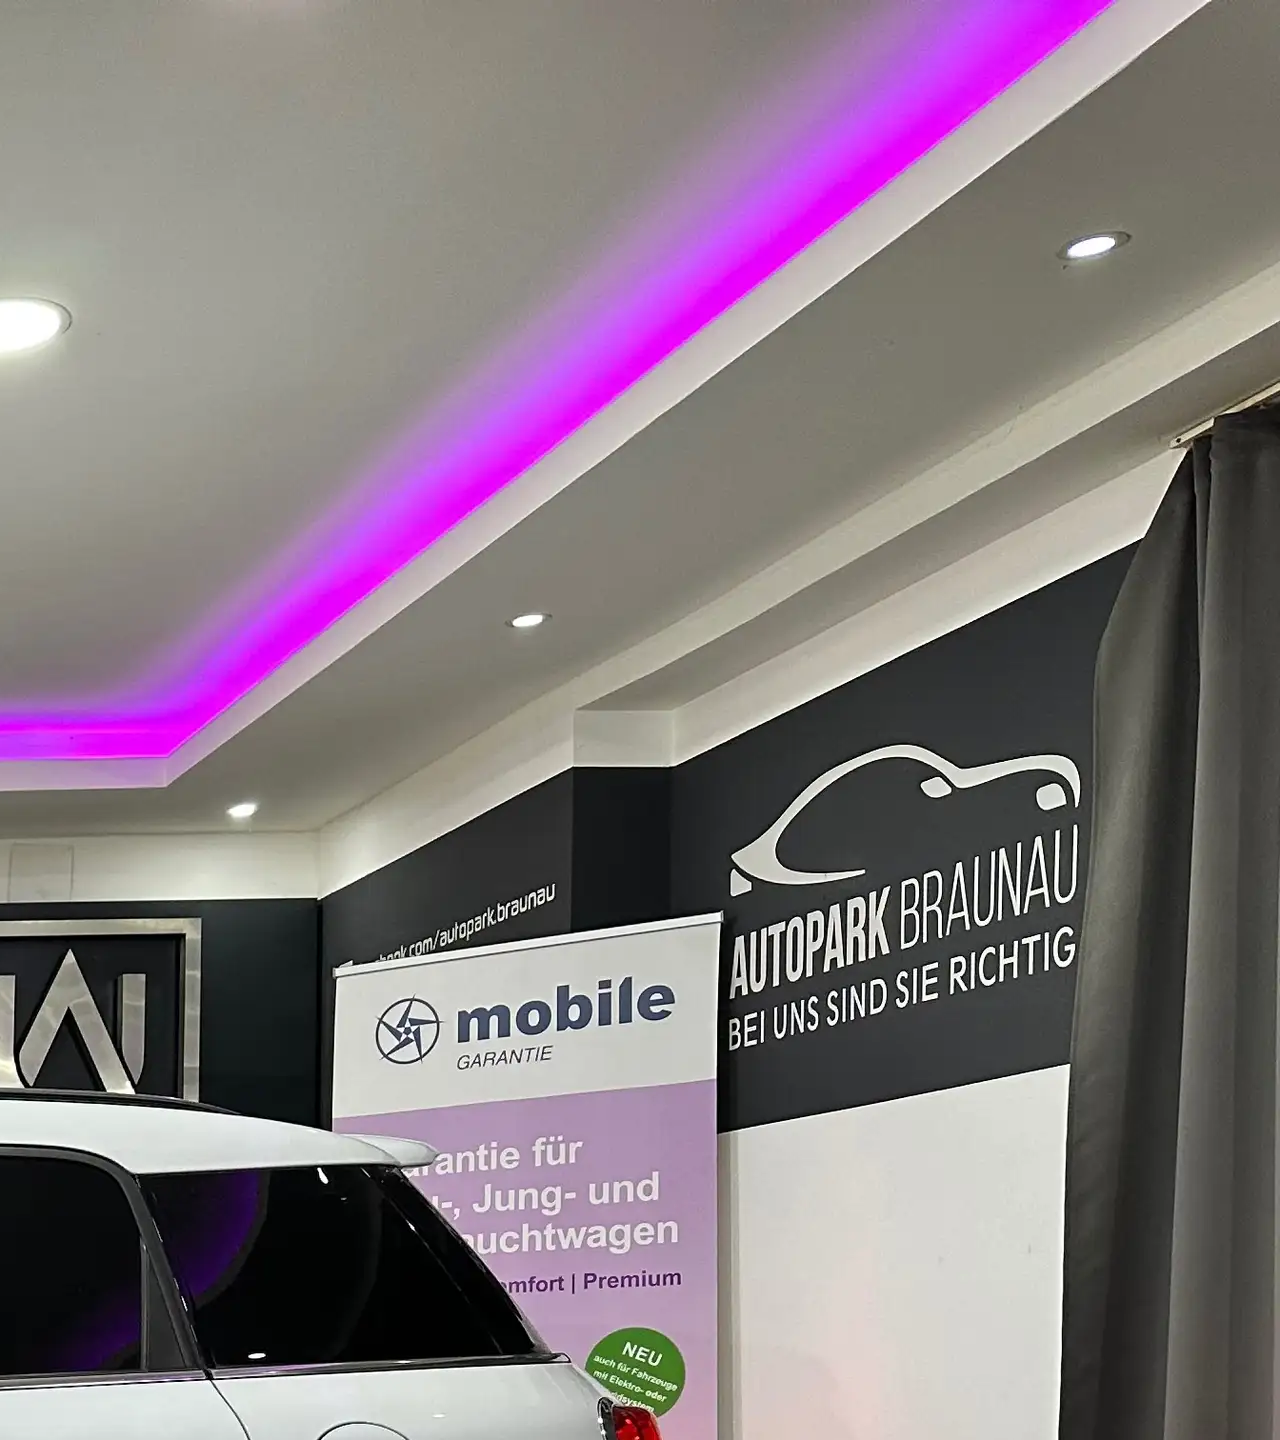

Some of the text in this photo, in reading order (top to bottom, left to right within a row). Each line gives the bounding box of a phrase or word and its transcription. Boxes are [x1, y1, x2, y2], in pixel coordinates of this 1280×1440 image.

[729, 824, 1079, 1000] AUTOPARK BRAUNAU
[729, 926, 1077, 1051] BEI UNS SIND SIE RICHTIG
[457, 975, 676, 1043] mobile
[456, 1044, 553, 1071] GARANTIE
[532, 1134, 584, 1168] für
[472, 1182, 576, 1216] Jung-
[589, 1171, 660, 1205] und
[584, 1269, 682, 1291] Premium
[622, 1341, 663, 1367] NEU
[592, 1369, 609, 1381] mit
[645, 1388, 668, 1402] oder
[593, 1354, 678, 1391] auch für Fahrzeuge
